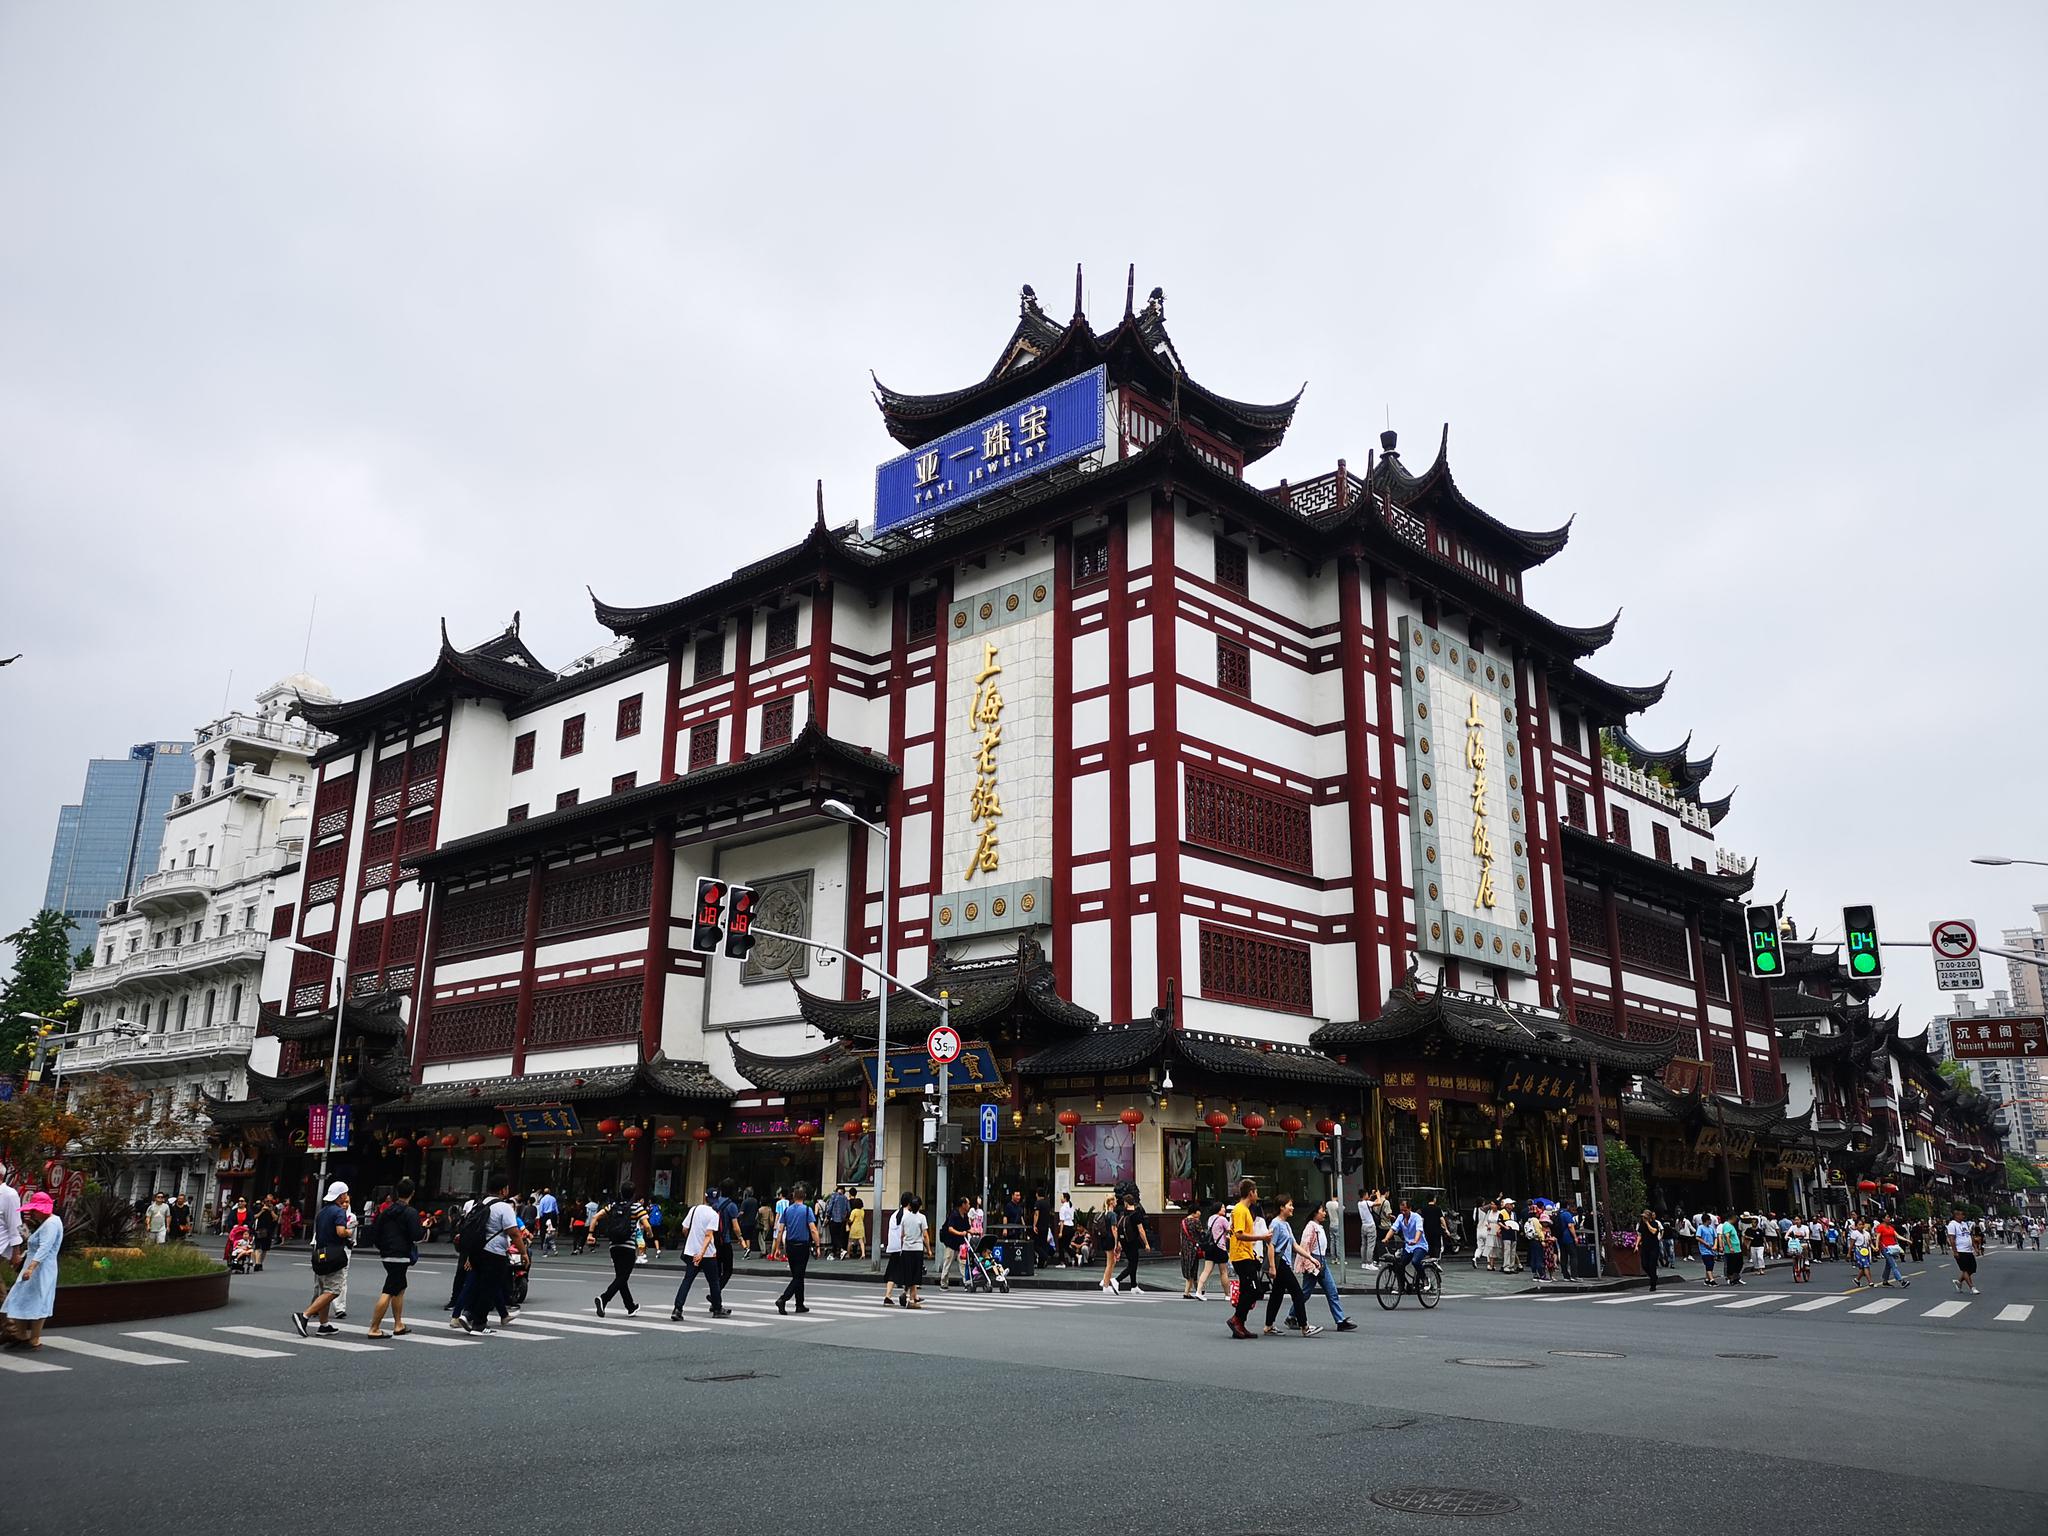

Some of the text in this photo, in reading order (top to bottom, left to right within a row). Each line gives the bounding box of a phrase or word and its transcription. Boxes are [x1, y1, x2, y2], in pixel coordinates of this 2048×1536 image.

[913, 405, 1048, 488] 亚一珠宝
[914, 442, 1047, 504] YAYI JEWELRY
[1753, 931, 1776, 949] 04
[1850, 931, 1874, 950] 04
[1956, 1024, 2012, 1040] 沉香阁
[934, 1037, 955, 1052] 3.5m
